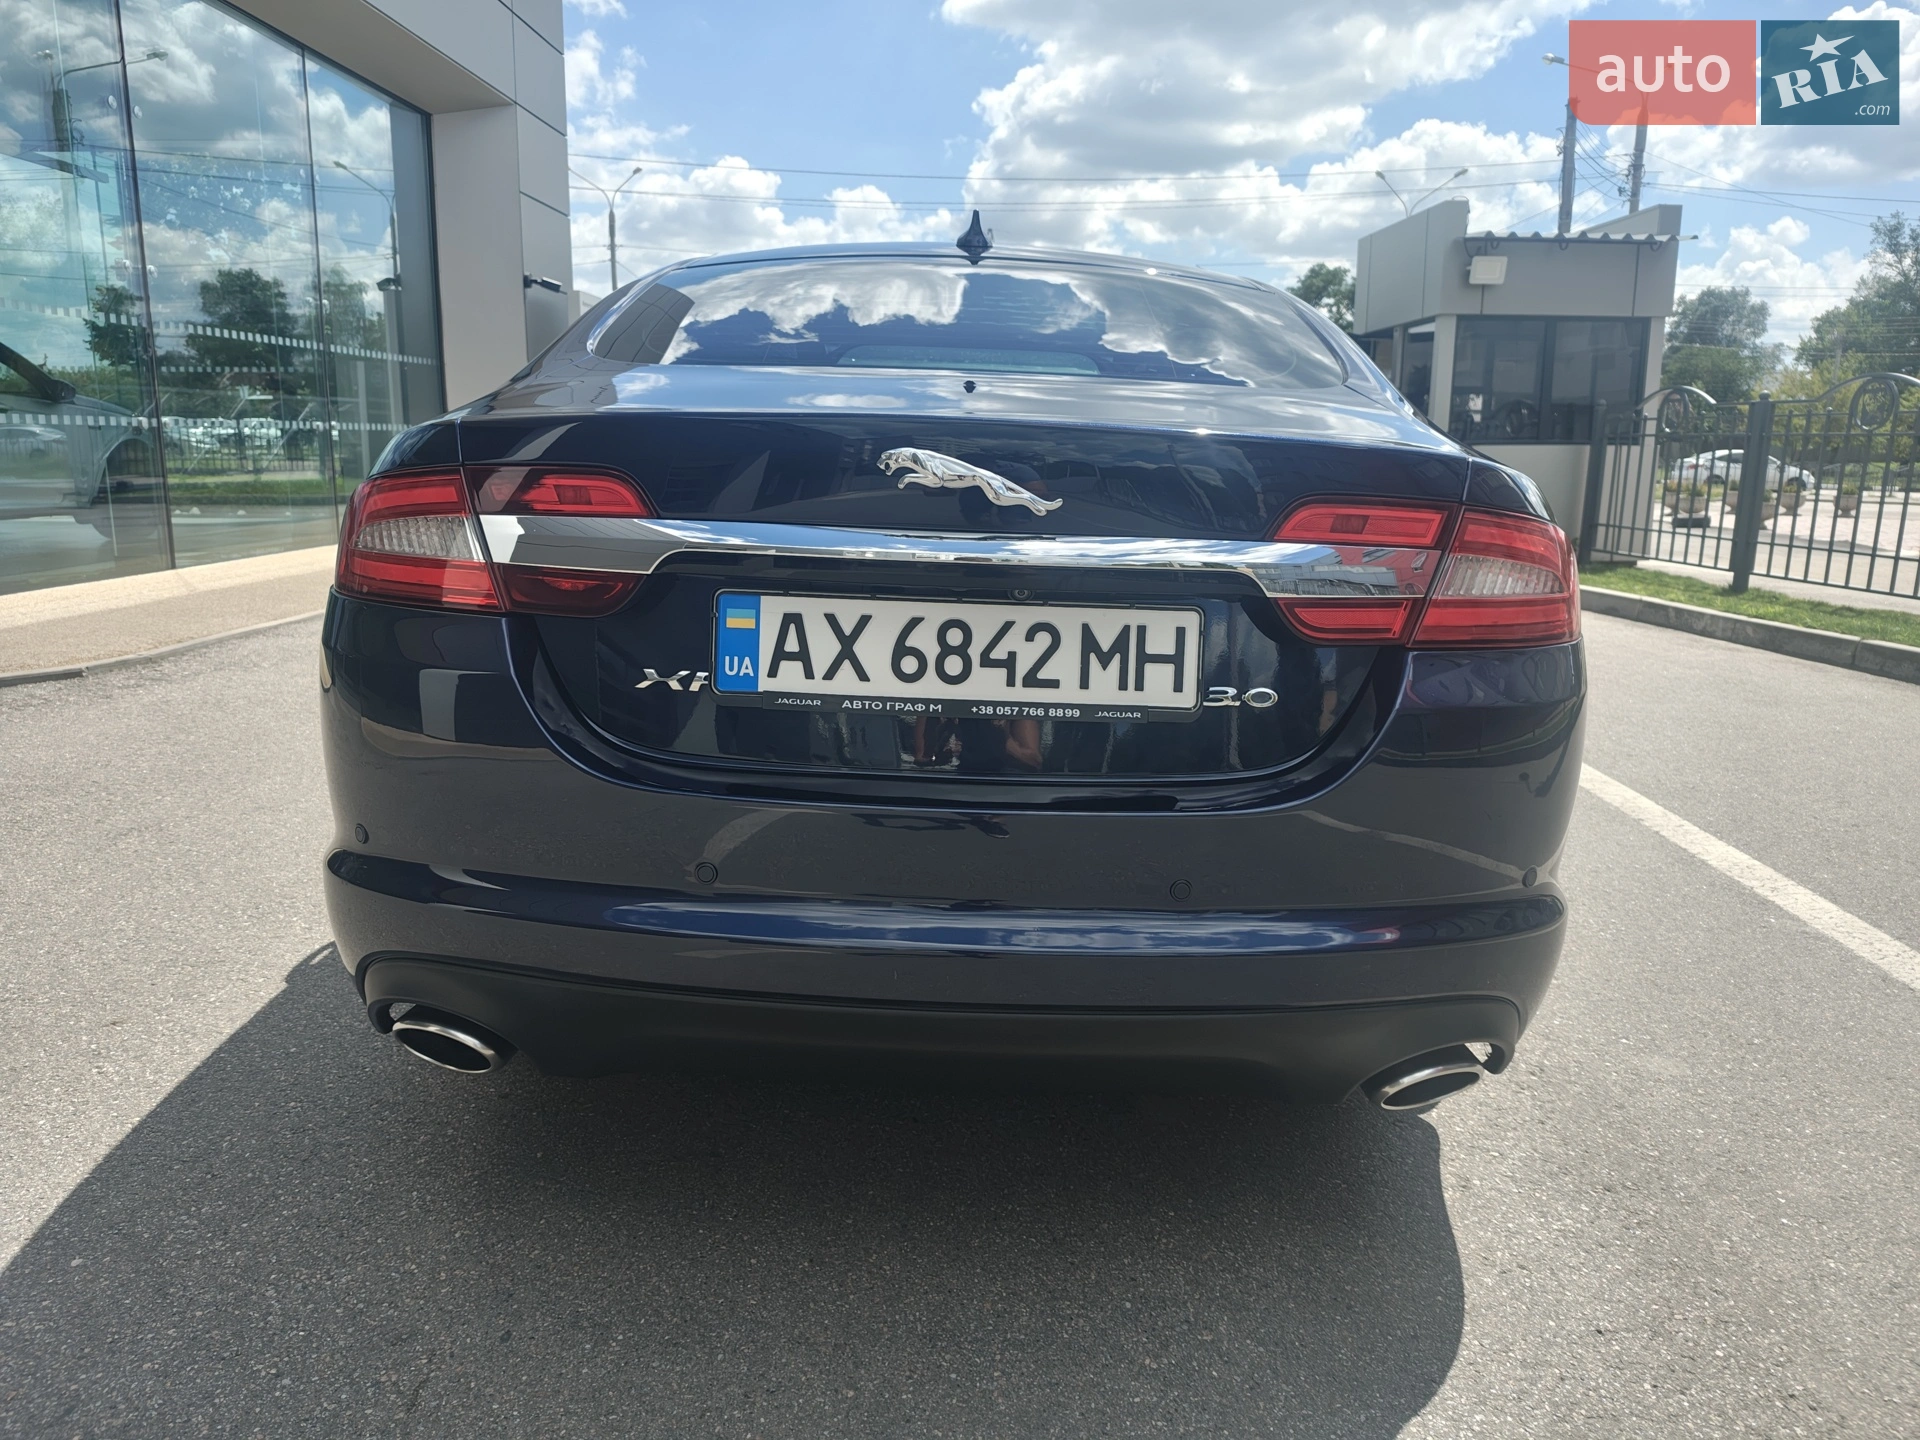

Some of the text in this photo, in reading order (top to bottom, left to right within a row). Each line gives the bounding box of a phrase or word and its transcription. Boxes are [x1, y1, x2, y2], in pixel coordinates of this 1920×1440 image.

[766, 612, 1186, 693] AX 6842 MH
[724, 655, 755, 677] UA
[774, 697, 822, 706] JAGUAR
[1202, 686, 1279, 708] 3.0
[841, 699, 942, 713] АВТО ГРАФ М
[971, 705, 1081, 718] +38 057 766 8899
[1094, 710, 1142, 719] JAGUAR
